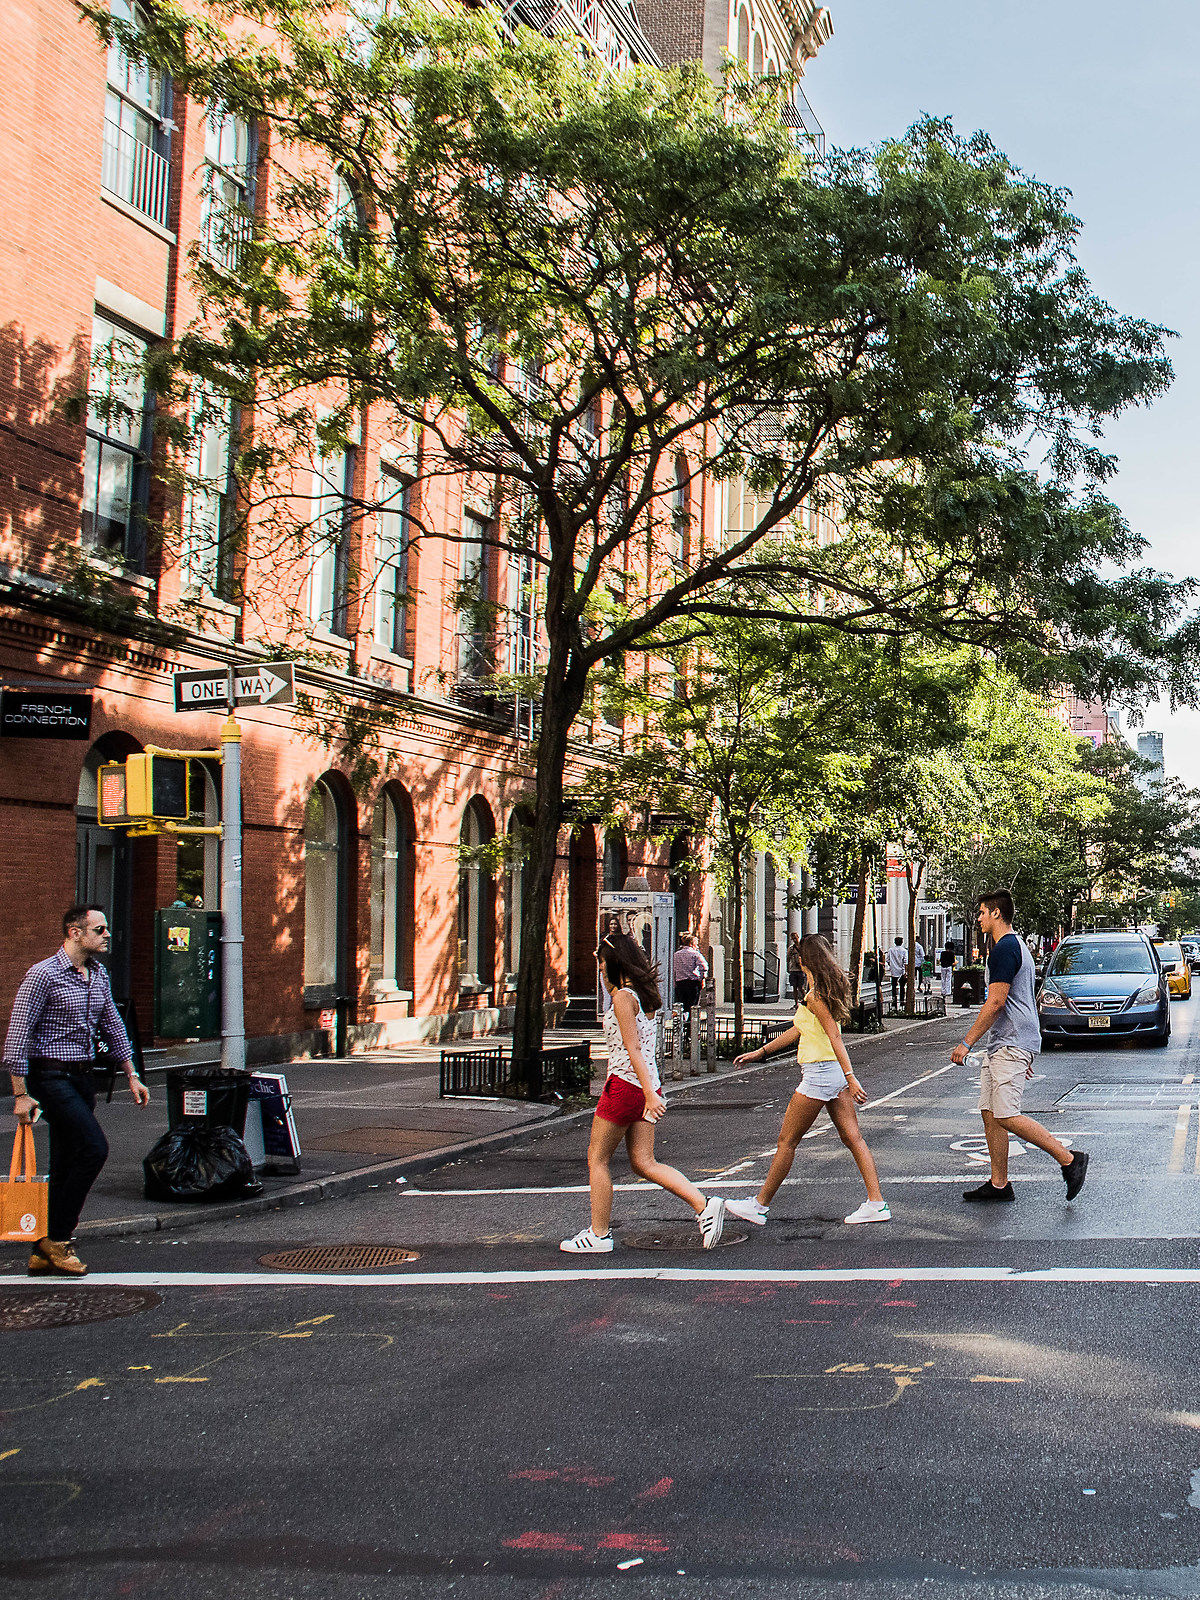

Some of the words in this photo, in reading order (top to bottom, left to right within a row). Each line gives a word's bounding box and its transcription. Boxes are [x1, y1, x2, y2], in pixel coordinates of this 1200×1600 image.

[191, 681, 226, 699] ONE
[240, 677, 275, 695] WAY
[21, 704, 72, 714] FRENCH
[5, 714, 87, 726] CONNECTION
[612, 895, 638, 903] Phone
